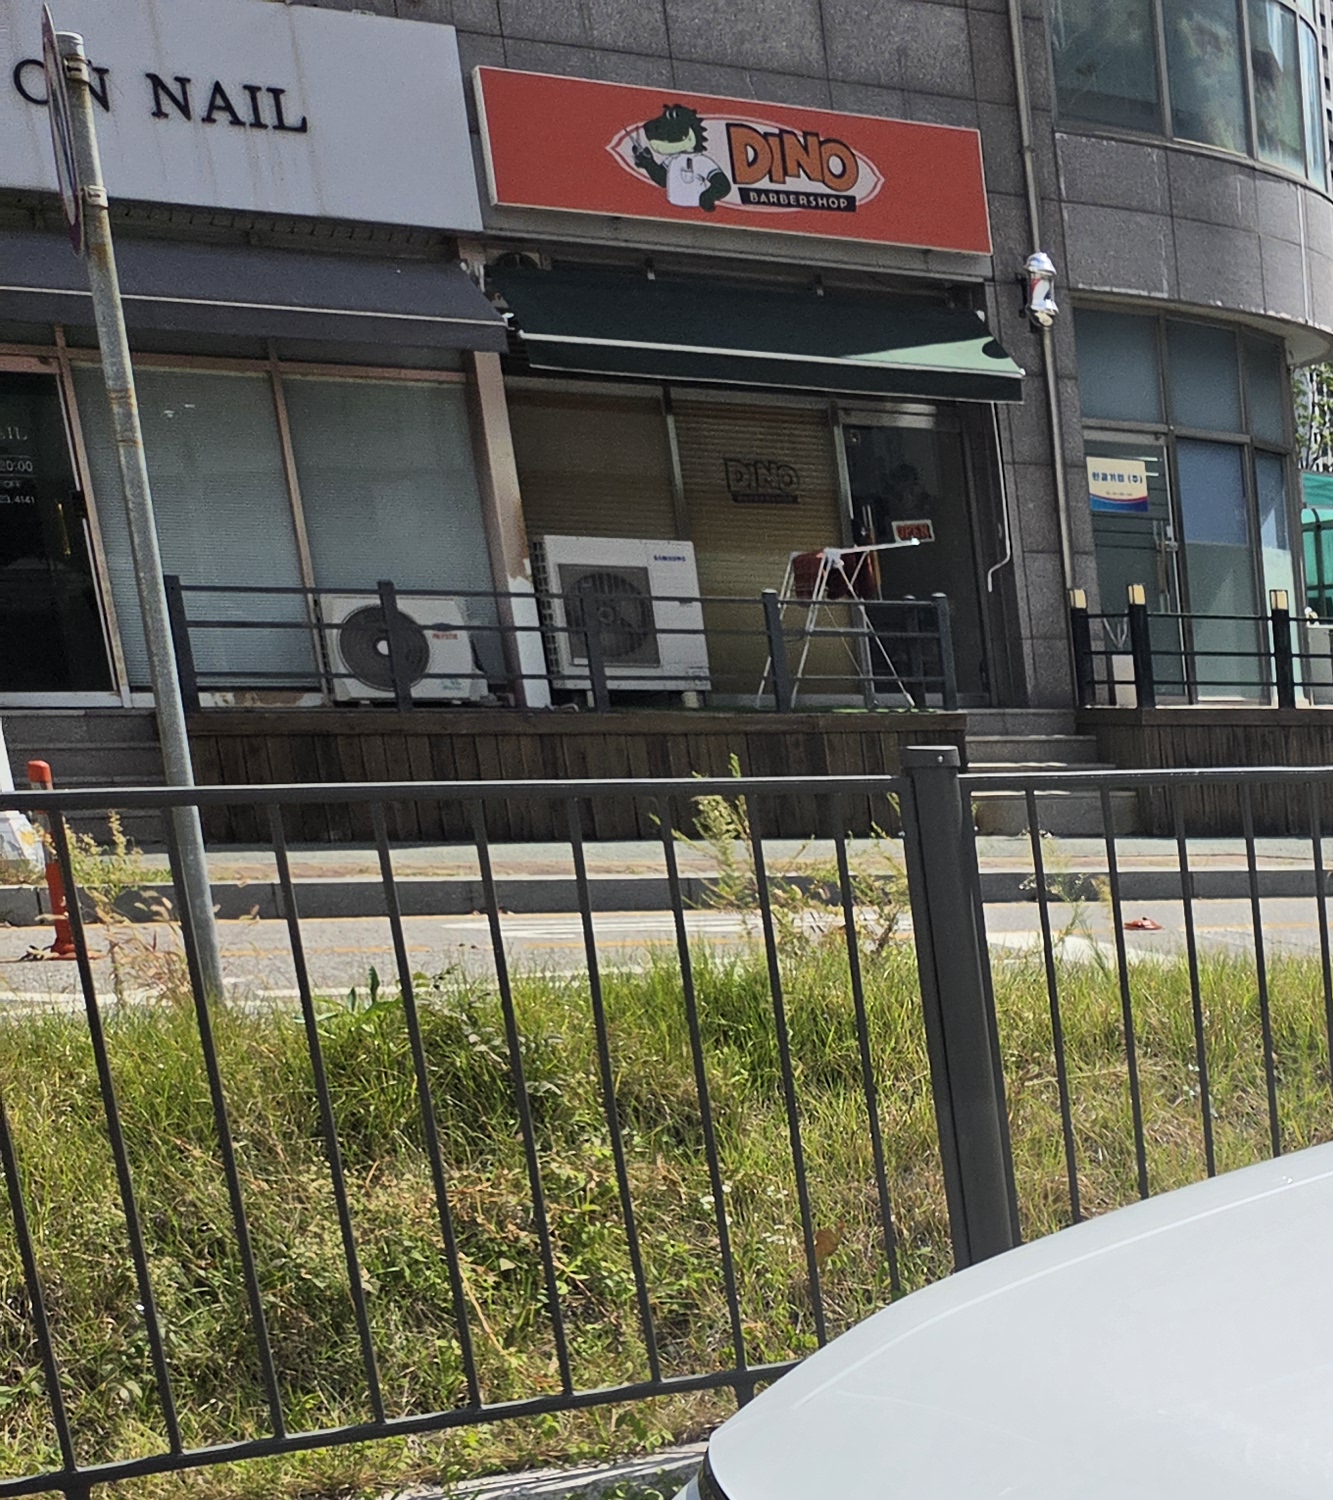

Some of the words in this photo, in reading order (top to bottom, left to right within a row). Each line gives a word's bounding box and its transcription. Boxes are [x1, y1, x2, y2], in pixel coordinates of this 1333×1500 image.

[145, 73, 307, 133] NAIL
[726, 123, 859, 192] DINO
[749, 191, 849, 210] BARBERSHOP
[723, 457, 800, 494] DINO
